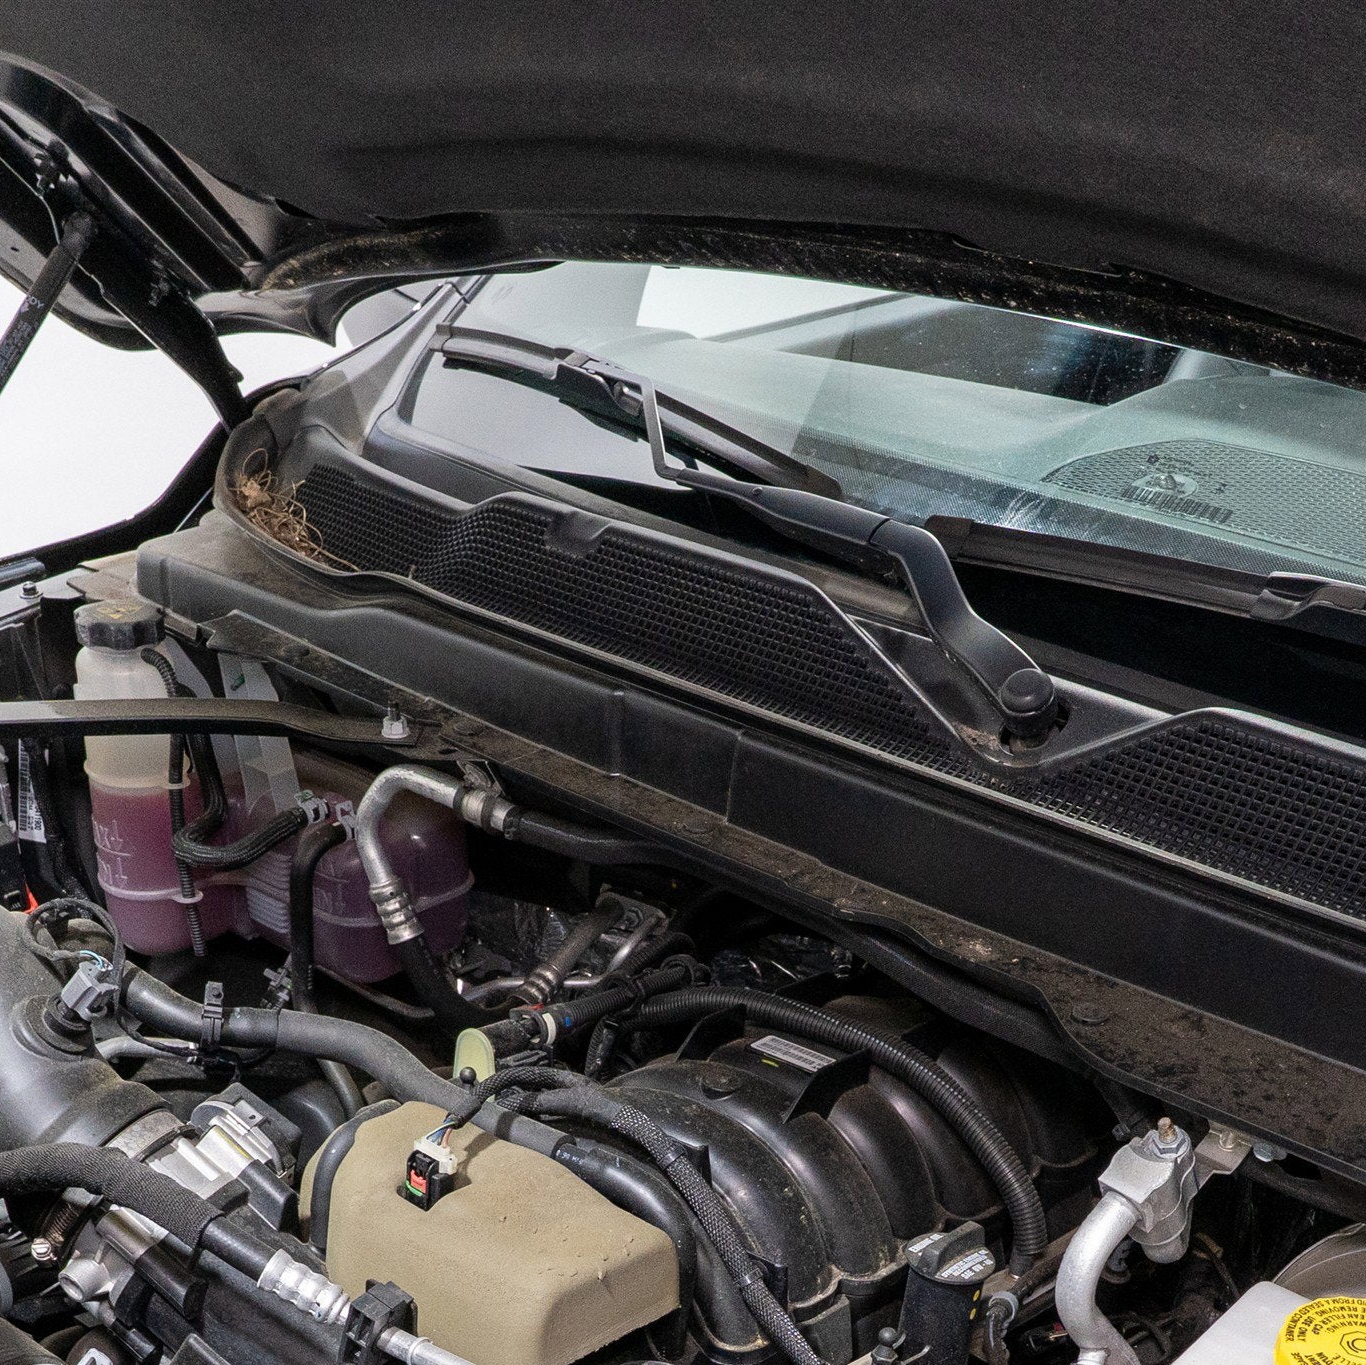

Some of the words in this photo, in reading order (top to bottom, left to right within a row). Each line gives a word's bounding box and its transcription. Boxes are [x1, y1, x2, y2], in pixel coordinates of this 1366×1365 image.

[1331, 1297, 1355, 1305] FROM
[1299, 1301, 1324, 1315] SEALED
[1304, 1315, 1315, 1327] USE
[1321, 1314, 1349, 1325] FILLER
[1297, 1325, 1308, 1342] ONLY
[1312, 1323, 1324, 1335] CAP
